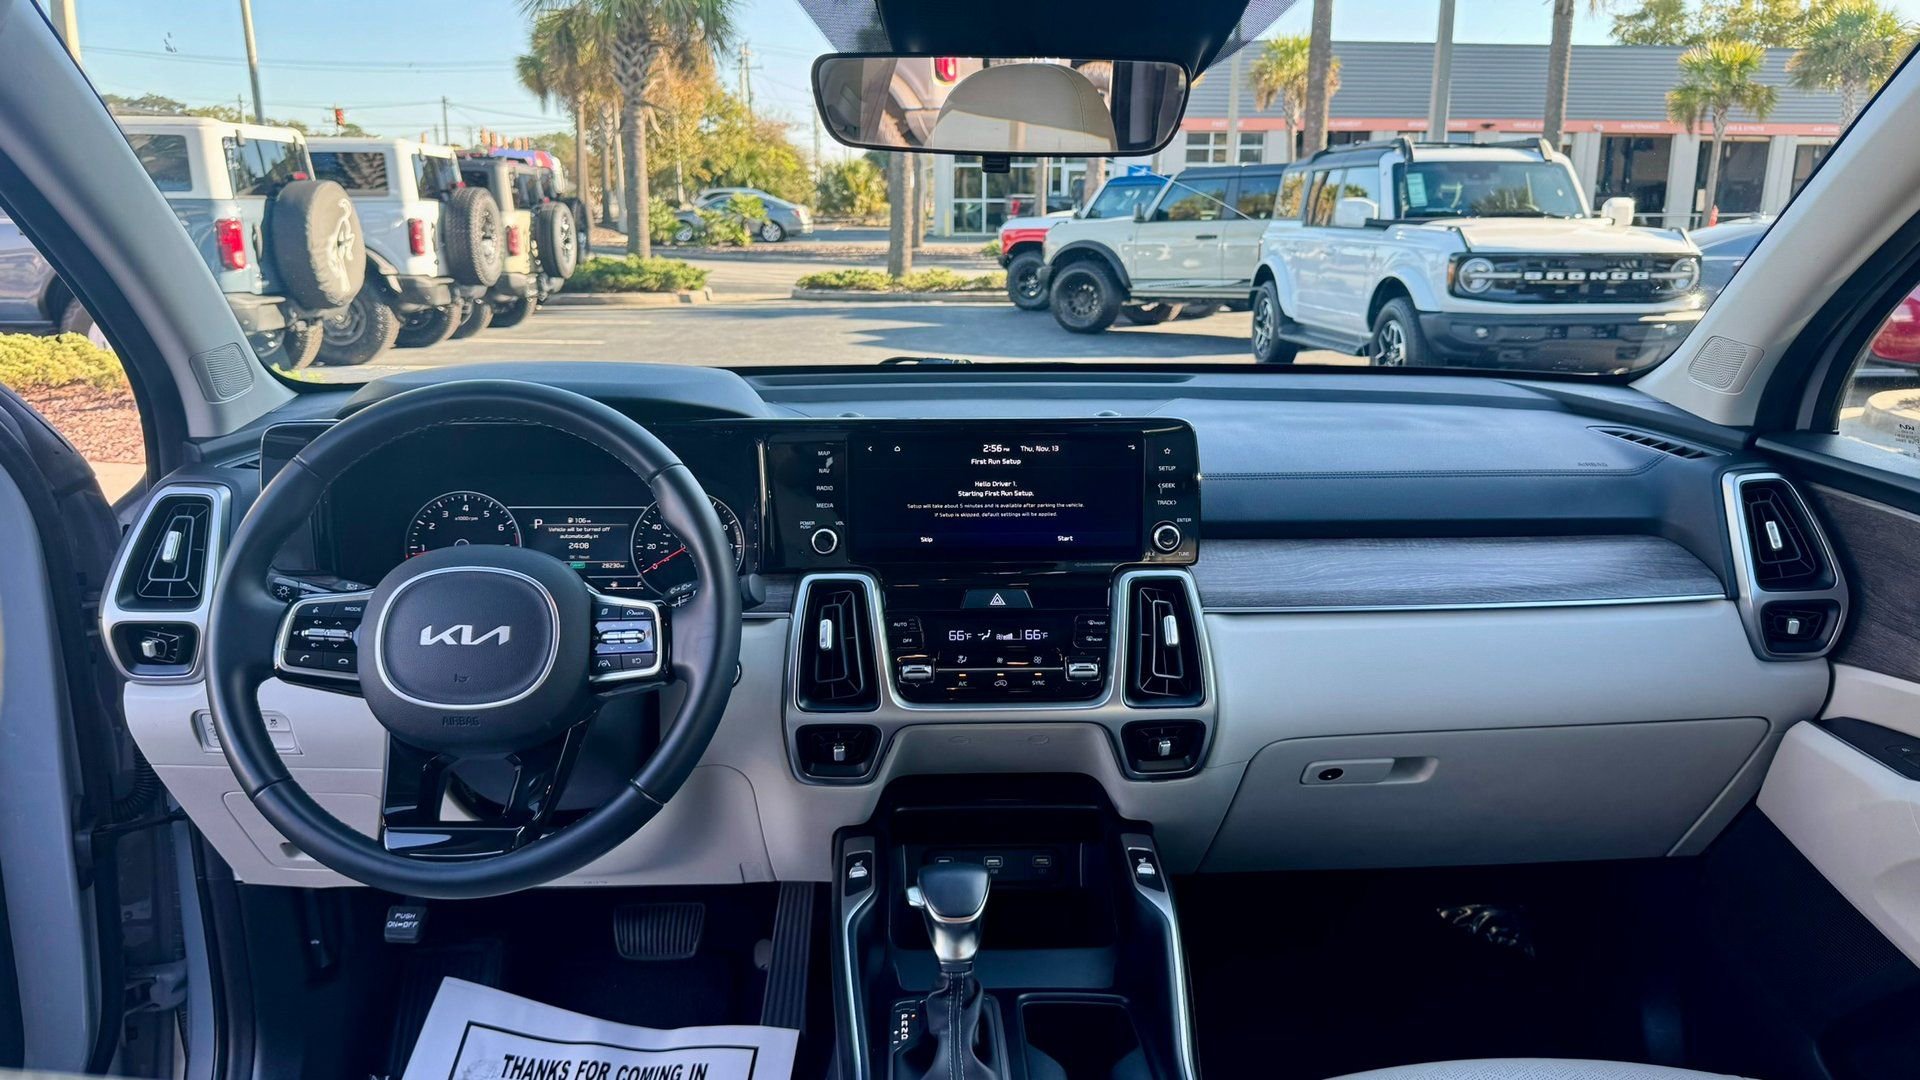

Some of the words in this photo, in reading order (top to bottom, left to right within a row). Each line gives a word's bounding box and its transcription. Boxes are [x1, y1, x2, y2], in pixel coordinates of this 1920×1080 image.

[1524, 271, 1649, 280] BRONCO
[983, 444, 1002, 453] 2:56
[1020, 445, 1035, 453] Thu,
[1002, 458, 1021, 466] Setup
[958, 490, 984, 498] Starting
[462, 504, 469, 512] 4
[442, 510, 449, 518] 3
[483, 510, 490, 518] 5
[428, 522, 436, 530] 2
[534, 518, 543, 529] P
[652, 523, 662, 531] 40
[568, 542, 590, 550] 24:08
[419, 624, 511, 646] KIA
[442, 716, 480, 726] AIRBAG
[501, 1053, 572, 1080] THANKS
[575, 1059, 611, 1080] FOR
[616, 1063, 683, 1080] COMING
[689, 1063, 709, 1080] IN
